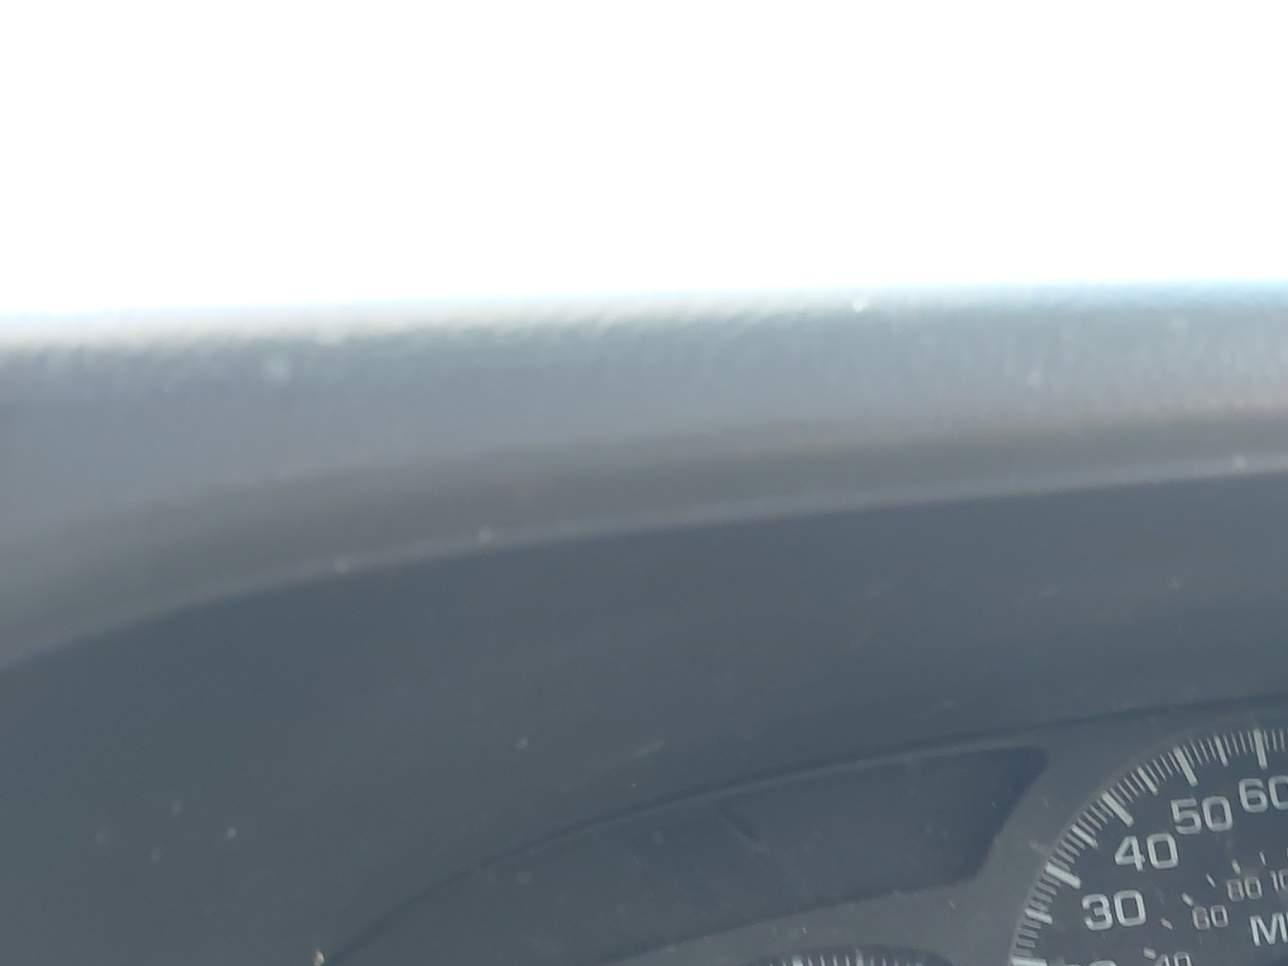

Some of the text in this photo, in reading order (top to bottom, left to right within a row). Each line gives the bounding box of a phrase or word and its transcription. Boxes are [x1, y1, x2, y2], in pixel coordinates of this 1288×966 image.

[1170, 796, 1234, 835] 50
[1113, 832, 1178, 871] 40
[1082, 890, 1146, 930] 30
